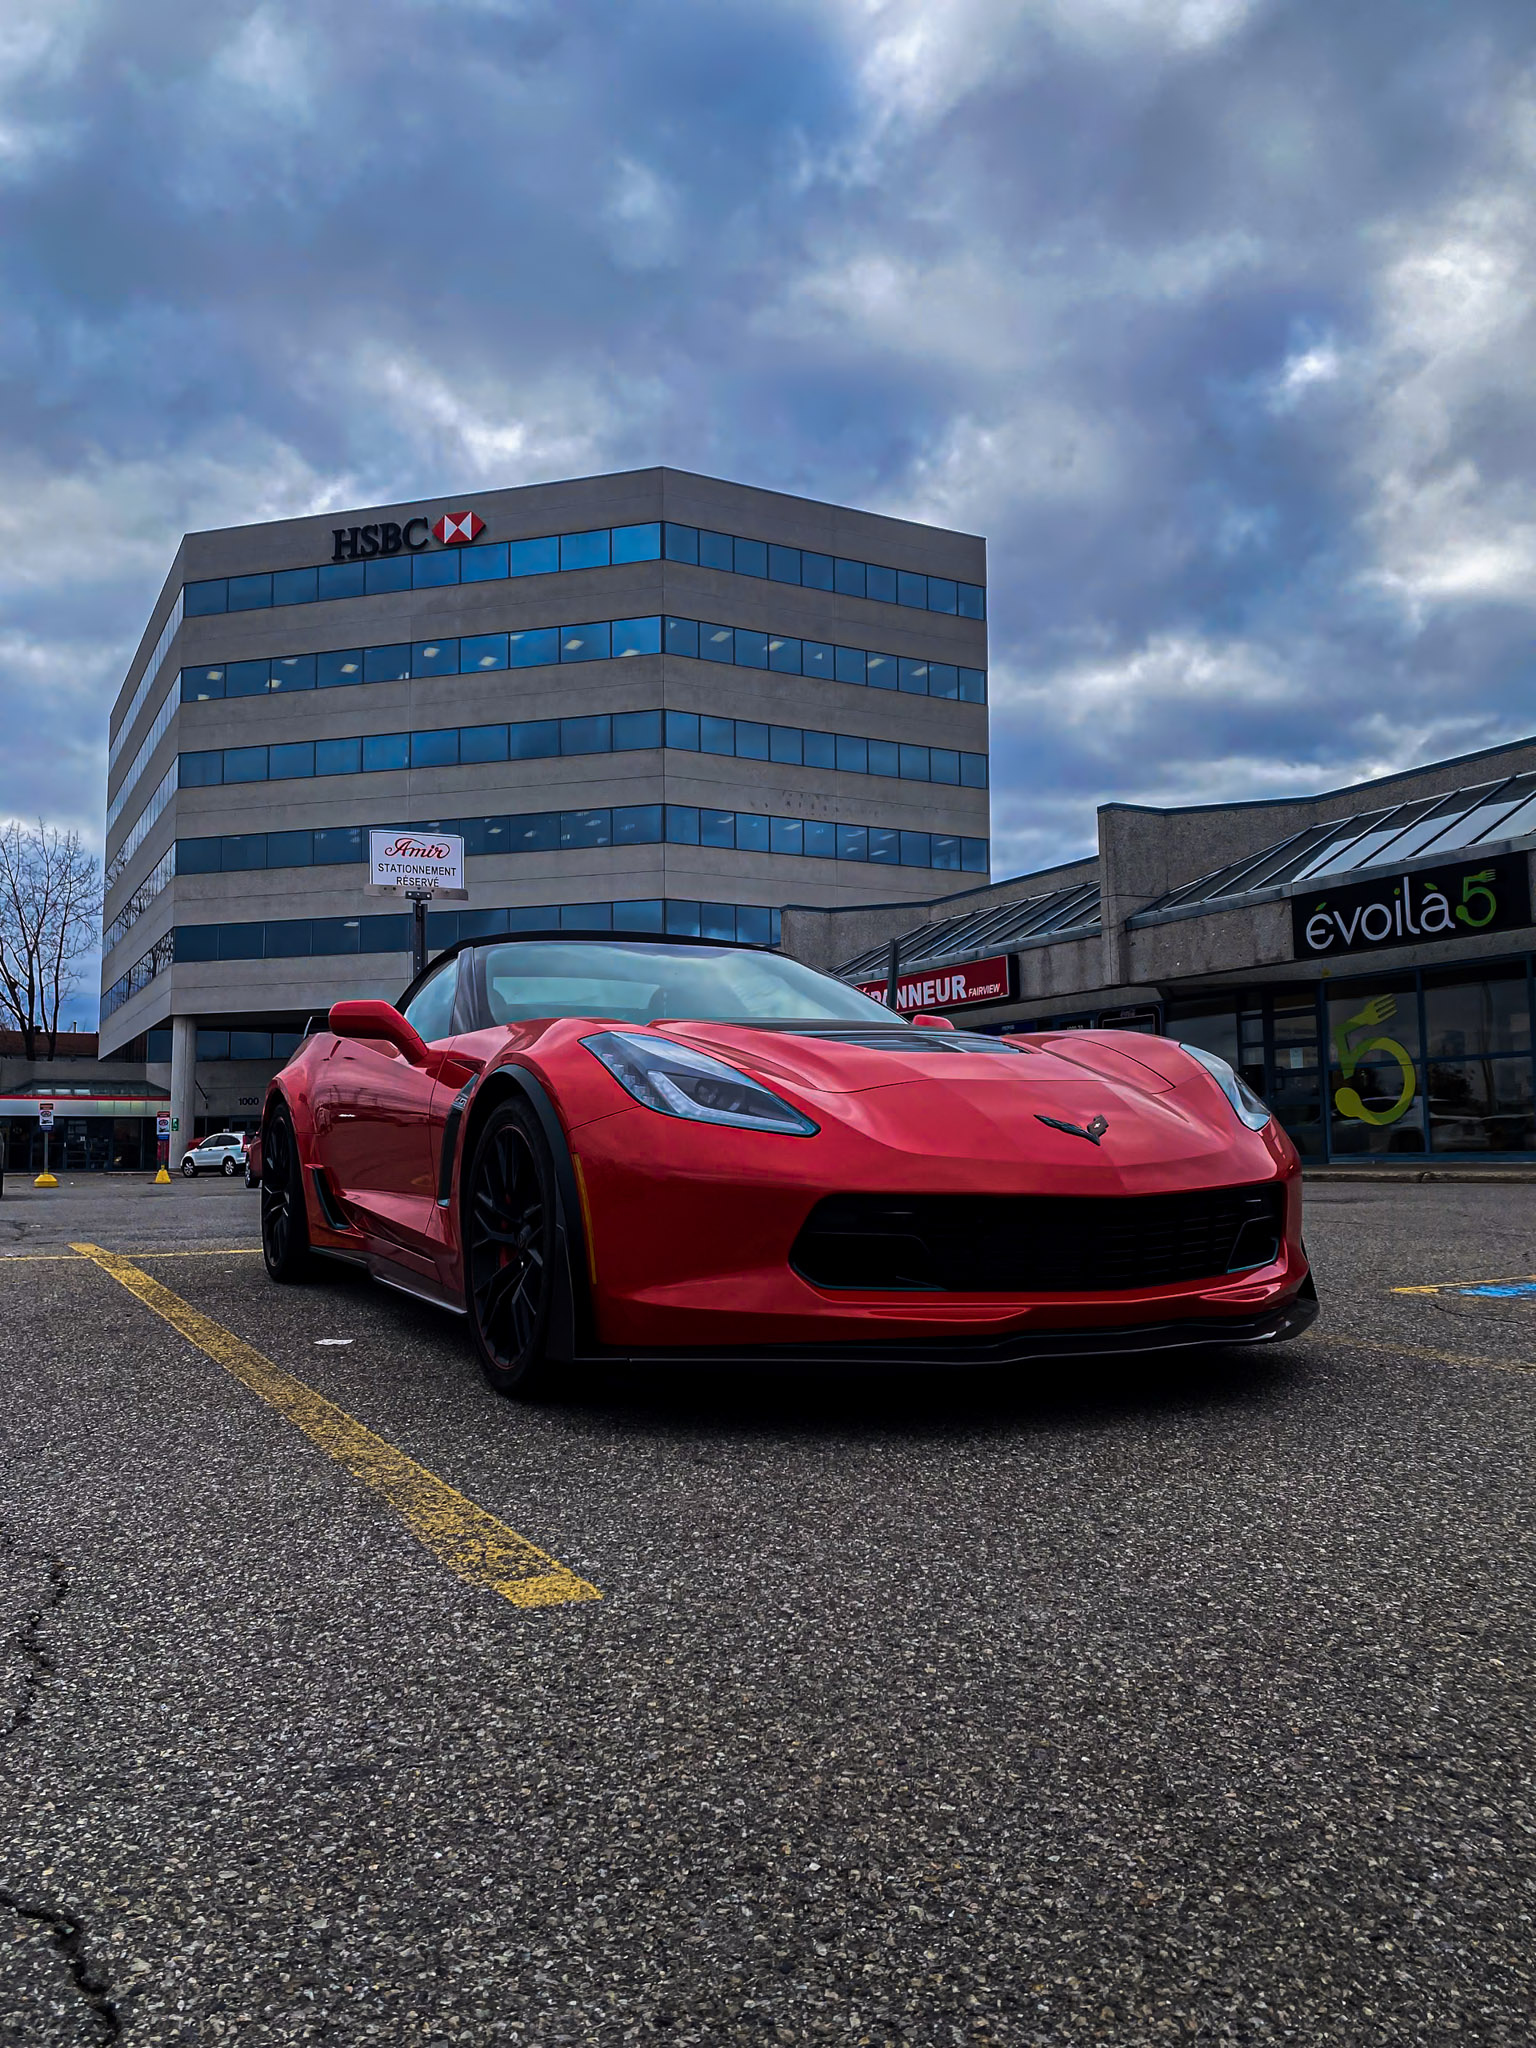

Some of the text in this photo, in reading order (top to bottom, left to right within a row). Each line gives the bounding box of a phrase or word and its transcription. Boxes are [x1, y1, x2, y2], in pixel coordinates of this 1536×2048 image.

[332, 517, 429, 561] HSBC
[385, 838, 450, 859] Amir
[378, 863, 456, 876] STATIONNEMENT
[396, 875, 440, 888] RÉSERVÉ
[968, 983, 1001, 998] FAIRVIEW
[238, 1097, 259, 1106] 1000
